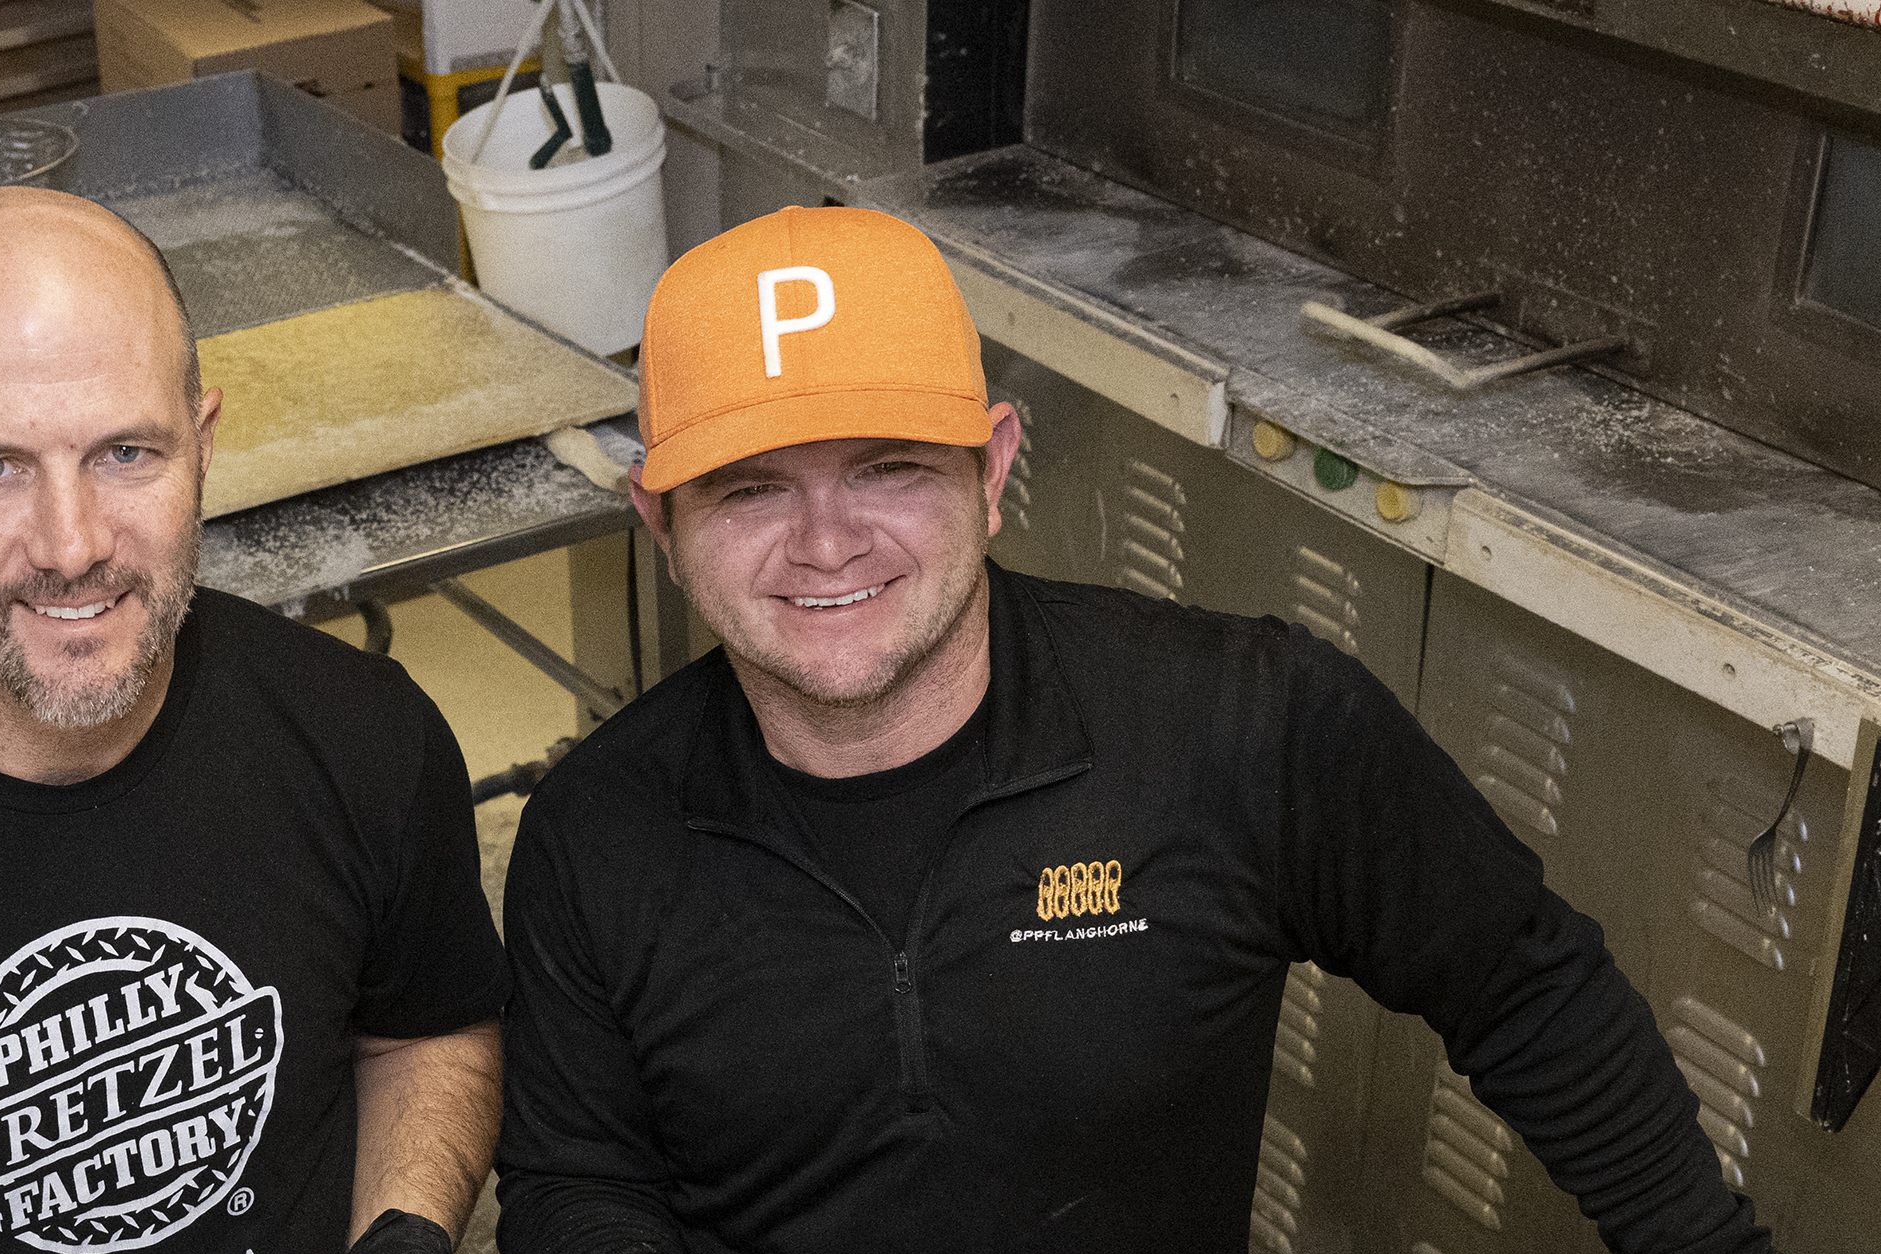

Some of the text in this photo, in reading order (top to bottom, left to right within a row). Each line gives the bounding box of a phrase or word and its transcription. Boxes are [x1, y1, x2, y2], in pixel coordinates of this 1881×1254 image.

[757, 265, 836, 378] P
[1009, 918, 1149, 943] @PPFLANGHORNE
[4, 1097, 246, 1230] FACTORY
